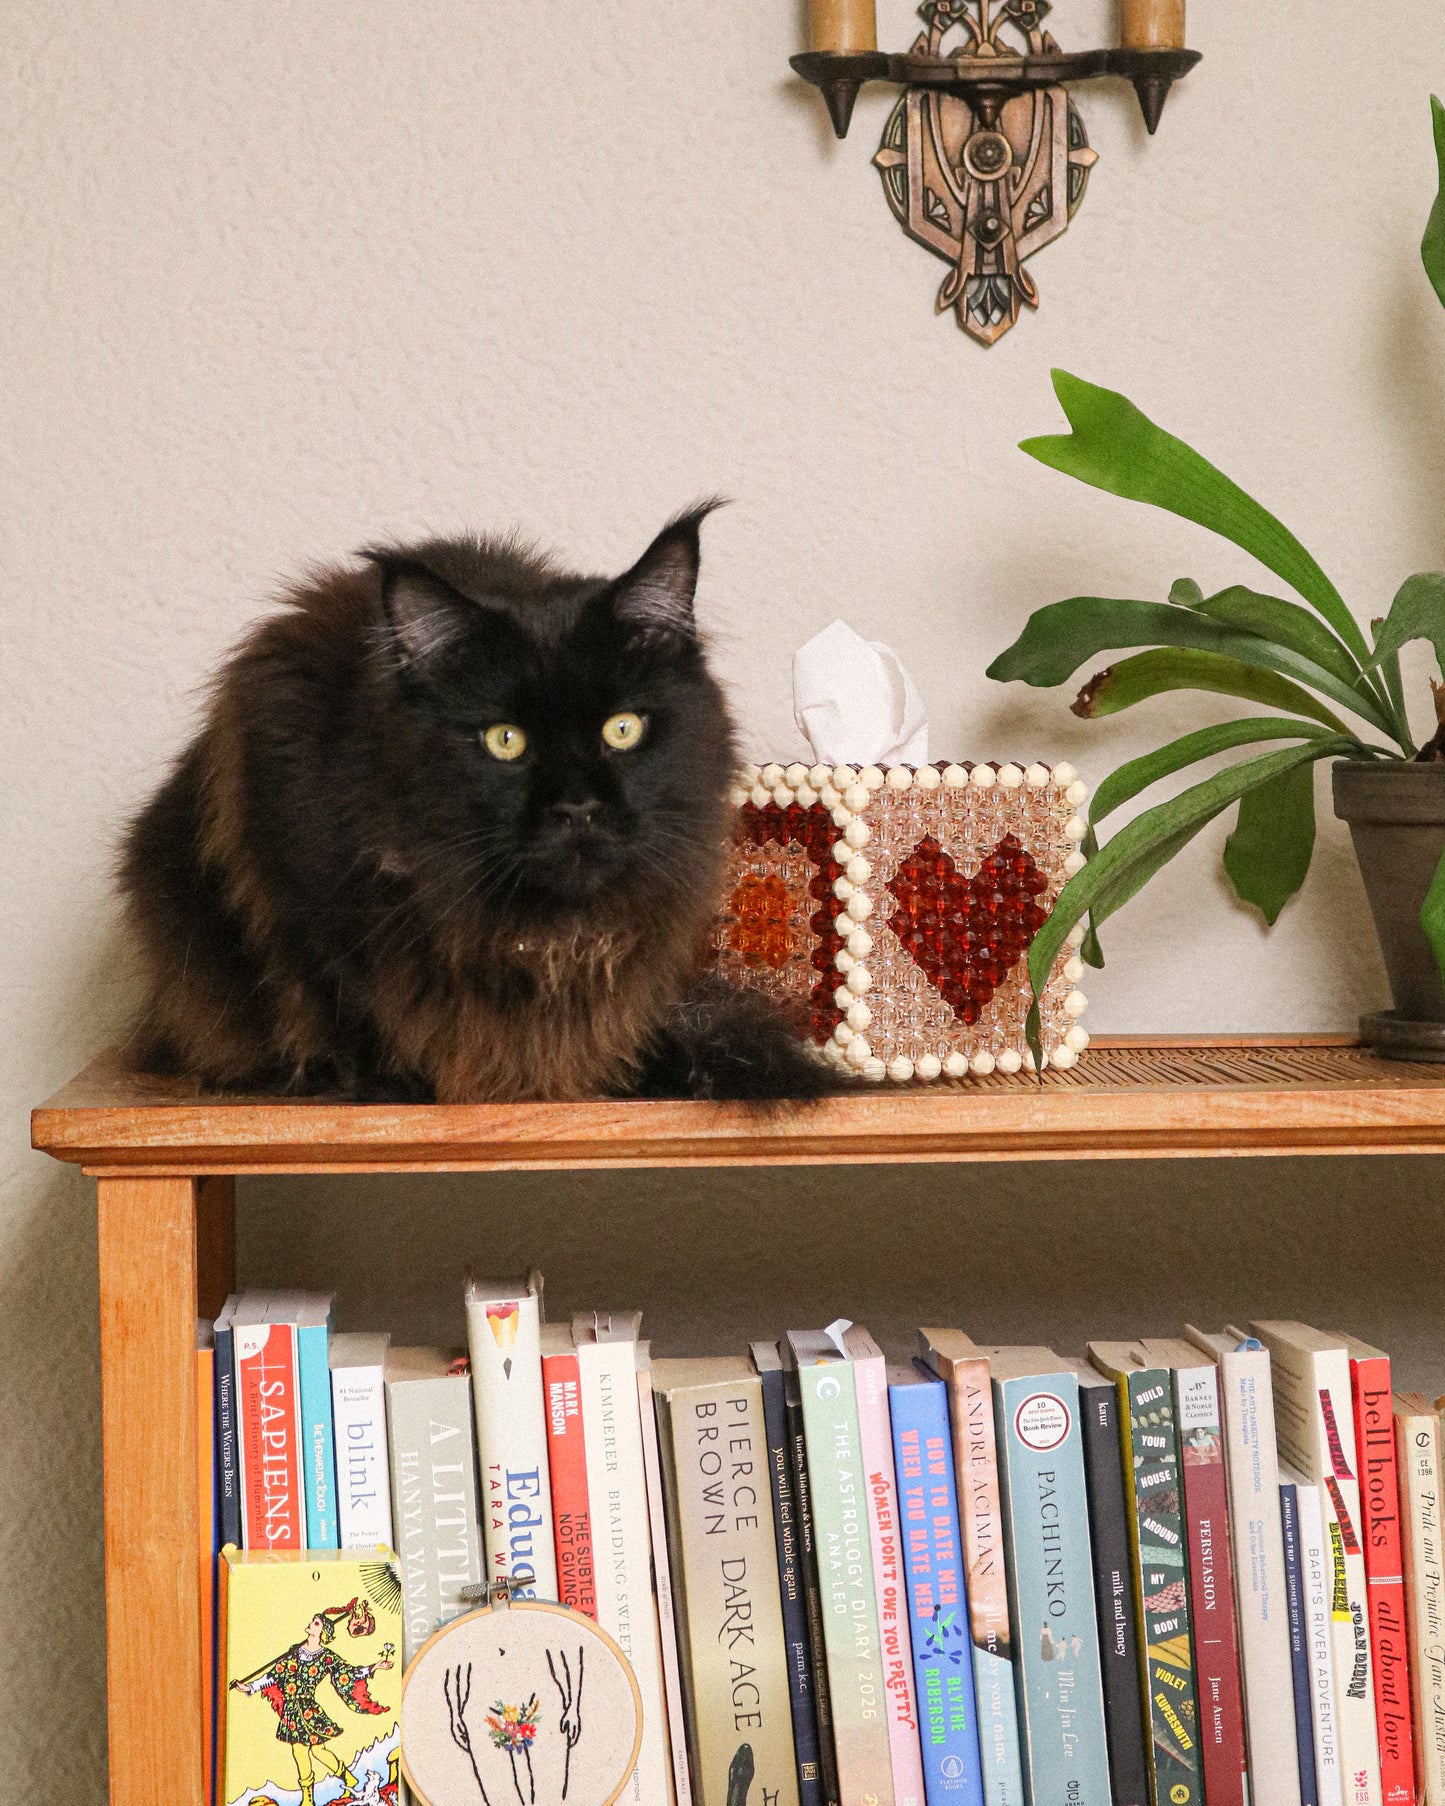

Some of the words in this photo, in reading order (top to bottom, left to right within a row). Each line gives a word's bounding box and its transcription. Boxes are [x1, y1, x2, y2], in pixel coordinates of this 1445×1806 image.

[244, 1342, 260, 1350] P.S.
[221, 1374, 231, 1410] WHERE
[249, 1381, 257, 1389] A
[563, 1381, 579, 1417] MARK
[1136, 1385, 1165, 1406] BUILD
[222, 1411, 230, 1429] THE
[250, 1392, 259, 1418] Brief
[550, 1382, 567, 1436] MANSON
[600, 1373, 618, 1472] KIMMERER
[1037, 1401, 1046, 1409] 10
[1098, 1402, 1109, 1427] kaur
[1185, 1411, 1214, 1419] CLASSICS
[1364, 1389, 1391, 1447] bell
[250, 1422, 260, 1460] History
[430, 1420, 461, 1446] A
[834, 1421, 851, 1460] THE
[966, 1385, 991, 1468] ANDRÉ
[1023, 1424, 1040, 1432] Book
[1040, 1422, 1063, 1430] Review
[1141, 1434, 1167, 1448] YOUR
[223, 1430, 233, 1469] WATERS
[260, 1381, 291, 1541] SAPIENS
[346, 1420, 376, 1510] blink
[726, 1399, 758, 1531] PIERCE
[772, 1448, 784, 1472] you
[795, 1435, 806, 1471] Witches,
[901, 1428, 922, 1477] WHEN
[926, 1437, 946, 1475] HOW
[1420, 1459, 1429, 1467] CE
[224, 1469, 234, 1497] BEGIN
[254, 1464, 261, 1475] of
[695, 1402, 727, 1535] BROWN
[777, 1473, 791, 1499] will
[1140, 1469, 1171, 1489] HOUSE
[1417, 1468, 1433, 1476] 1396
[253, 1479, 265, 1539] Humankind
[401, 1451, 423, 1540] HANYA
[489, 1464, 504, 1529] TARA
[799, 1471, 810, 1512] Midwives
[869, 1472, 892, 1532] WOMEN
[906, 1486, 926, 1520] YOU
[930, 1485, 949, 1507] TO
[1368, 1457, 1395, 1547] hooks
[575, 1512, 589, 1541] THE
[779, 1501, 793, 1524] feel
[802, 1513, 811, 1521] &
[838, 1469, 864, 1588] ASTROLOGY
[973, 1479, 995, 1576] ACIMAN
[1284, 1497, 1293, 1529] ANNUAL
[1421, 1490, 1436, 1532] Pride
[559, 1513, 574, 1546] NOT
[608, 1490, 627, 1585] BRAIDING
[782, 1526, 796, 1564] whole
[802, 1522, 812, 1553] Nurses
[933, 1515, 954, 1560] DATE
[1037, 1470, 1067, 1618] PACHINKO
[1142, 1517, 1179, 1545] AROUND
[1286, 1530, 1294, 1543] NP
[881, 1536, 897, 1581] DON'T
[909, 1529, 931, 1574] HATE
[1199, 1519, 1217, 1611] PERSUASION
[1287, 1544, 1295, 1562] TRIP
[1329, 1522, 1350, 1612] BETHLEHEM
[1423, 1537, 1439, 1565] and
[561, 1552, 578, 1606] GIVING
[577, 1547, 594, 1605] SUBTLE
[783, 1566, 797, 1601] again
[938, 1569, 958, 1605] MEN
[1111, 1571, 1124, 1596] milk
[1150, 1573, 1165, 1585] MY
[1289, 1574, 1298, 1606] SUMMER
[1308, 1548, 1323, 1605] BART'S
[407, 1548, 429, 1652] YANAGI
[718, 1557, 755, 1650] DARK
[883, 1587, 897, 1620] OWE
[914, 1582, 935, 1618] MEN
[985, 1596, 1002, 1623] cll
[1113, 1599, 1126, 1620] and
[1291, 1609, 1299, 1625] 2017
[1377, 1601, 1400, 1633] all
[1424, 1571, 1442, 1637] Prejudice
[617, 1594, 634, 1666] SWEET
[851, 1599, 872, 1660] DIARY
[884, 1626, 900, 1656] YOU
[986, 1629, 998, 1653] me
[1115, 1622, 1128, 1657] honey
[1153, 1618, 1179, 1635] BODY
[1313, 1613, 1327, 1660] RIVER
[1350, 1601, 1367, 1650] JOAN
[792, 1642, 805, 1672] parm
[988, 1658, 1002, 1681] by
[1379, 1639, 1402, 1705] about
[1424, 1644, 1445, 1690] Jane
[797, 1673, 809, 1693] k.c.
[1058, 1670, 1075, 1703] Min
[1155, 1667, 1188, 1691] VIOLET
[1208, 1677, 1222, 1702] Jane
[1346, 1652, 1367, 1699] DIDION
[730, 1659, 763, 1732] AGE
[858, 1672, 877, 1720] 2026
[886, 1661, 916, 1730] PRETTY
[925, 1668, 946, 1745] ROBERSON
[946, 1676, 967, 1732] BLYTHE
[989, 1683, 1003, 1716] your
[1057, 1707, 1077, 1728] Jin
[1154, 1692, 1194, 1751] KUPERSMITH
[1213, 1706, 1225, 1744] Austen
[1318, 1668, 1334, 1766] ADVENTURE
[992, 1723, 1006, 1764] name
[1063, 1732, 1079, 1758] Lee
[1383, 1712, 1405, 1760] love
[680, 1777, 688, 1796] HALL
[1355, 1791, 1369, 1802] FSG
